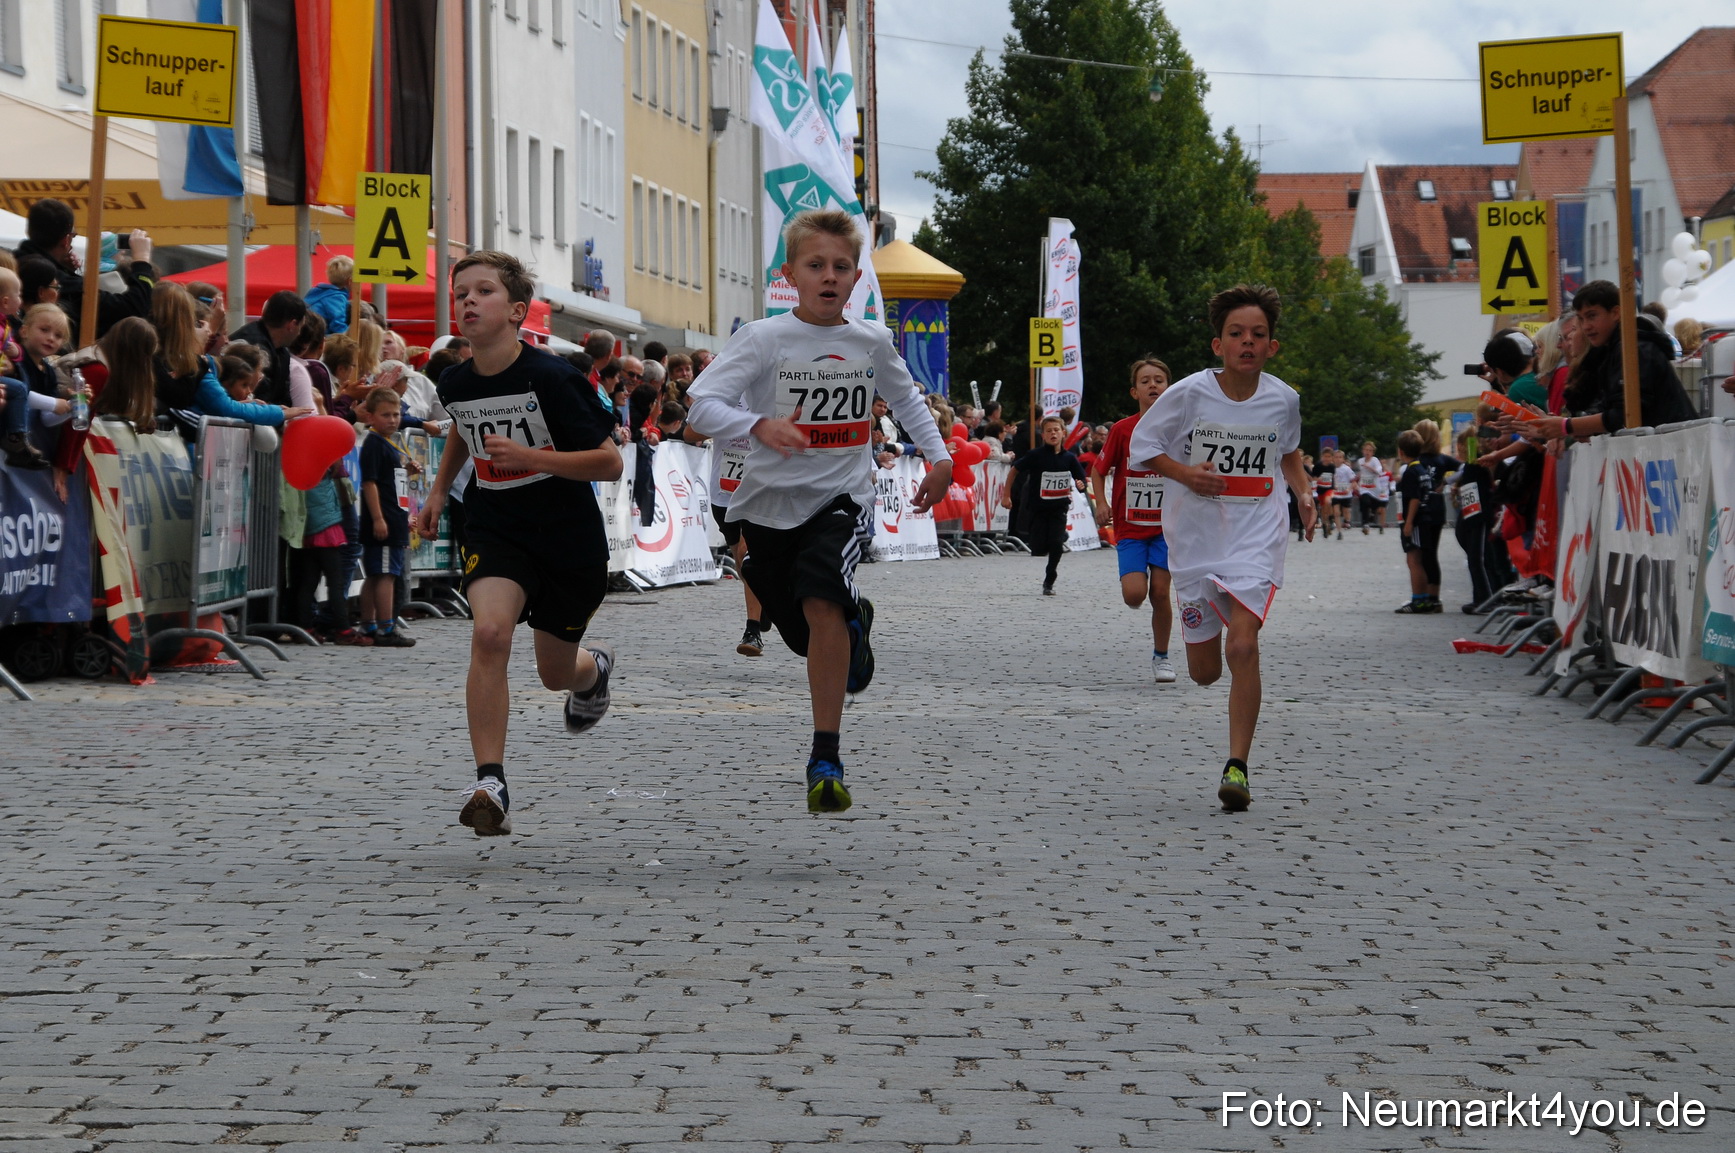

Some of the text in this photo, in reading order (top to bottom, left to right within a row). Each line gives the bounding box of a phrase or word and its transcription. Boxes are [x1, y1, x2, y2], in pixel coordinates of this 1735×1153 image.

[106, 45, 225, 75] Schnupper-
[145, 76, 184, 97] lauf
[1490, 67, 1612, 90] Schnupper-
[1532, 93, 1571, 114] lauf
[364, 177, 421, 198] Block
[1487, 206, 1546, 227] Block
[369, 207, 411, 260] A
[1496, 235, 1540, 289] A
[1033, 319, 1059, 329] Block
[1038, 333, 1055, 357] B
[779, 370, 863, 380] PARTL Neumarkt
[479, 405, 523, 418] Neumarkt
[789, 385, 867, 421] 7220
[810, 428, 849, 444] David
[1195, 428, 1266, 441] PARTL Neumarkt
[1202, 443, 1267, 475] 7344
[1046, 479, 1069, 489] 7163
[1132, 490, 1164, 508] 717
